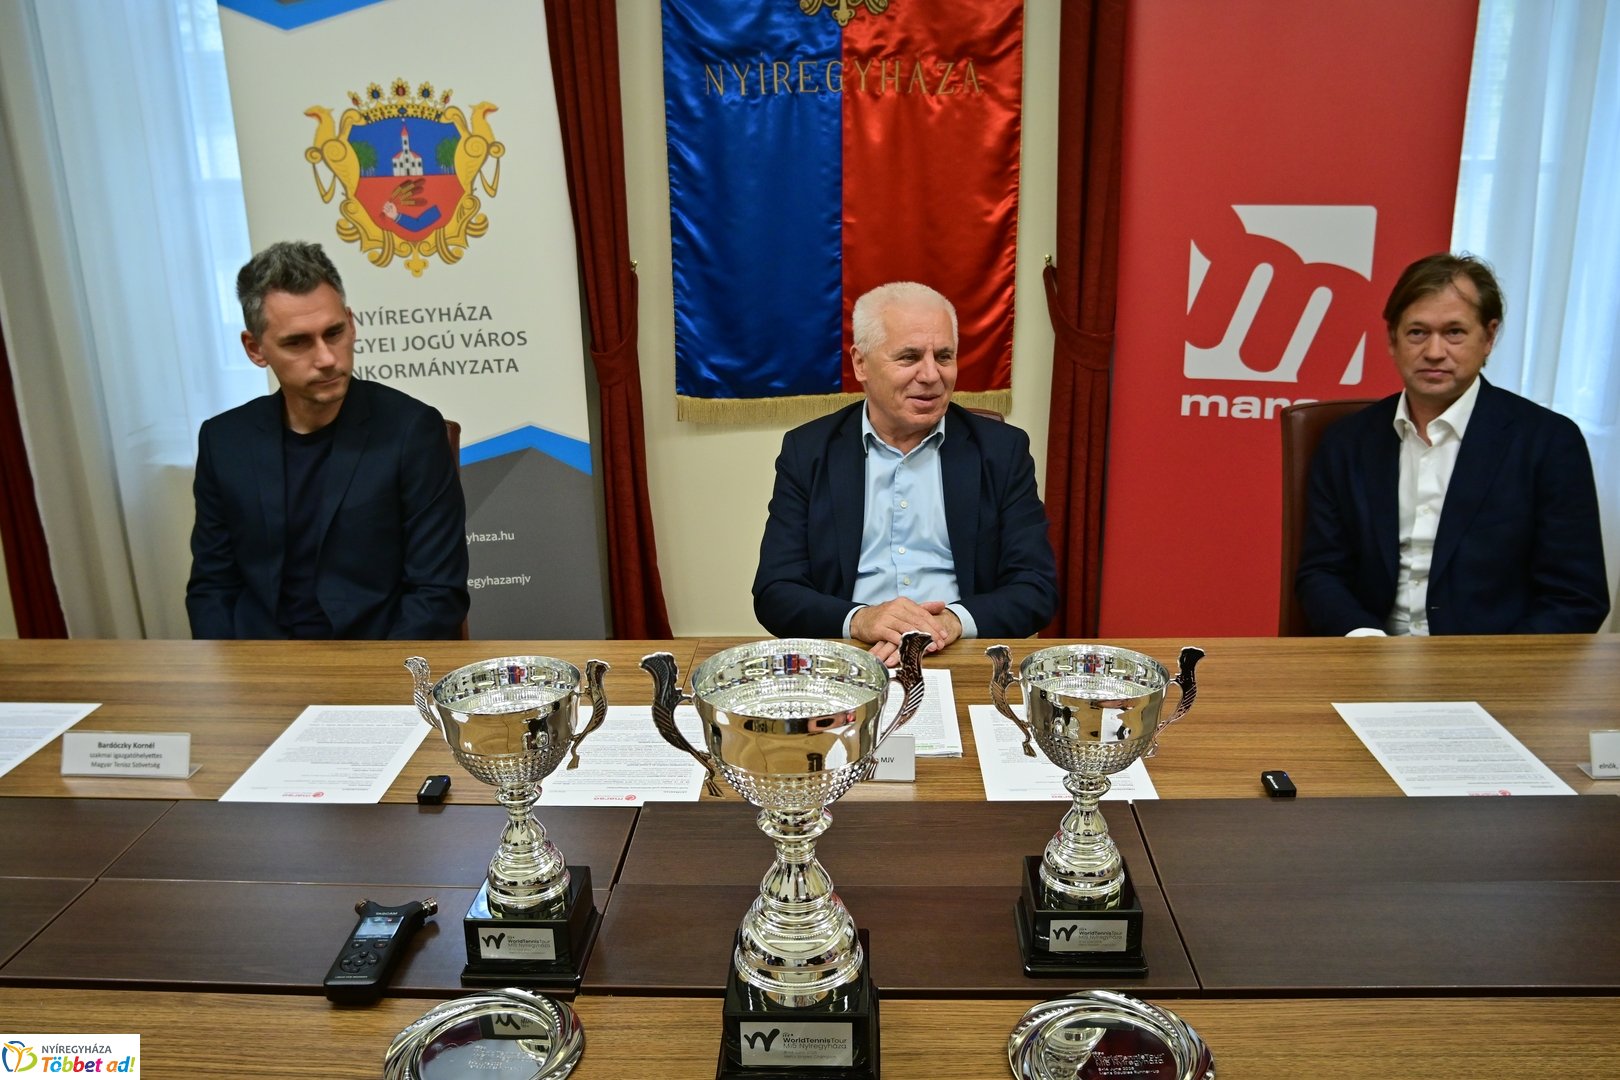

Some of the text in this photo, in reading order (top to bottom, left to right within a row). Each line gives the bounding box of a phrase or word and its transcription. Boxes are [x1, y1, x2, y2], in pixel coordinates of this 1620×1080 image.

[353, 303, 493, 327] NYÍREGYHÁZA
[353, 330, 528, 354] GYEI JOGÚ VÁROS
[351, 358, 520, 381] NKORMÁNYZATA
[1180, 394, 1319, 419] mar
[466, 531, 515, 545] yhaza.hu
[467, 574, 531, 589] egyhazamjv
